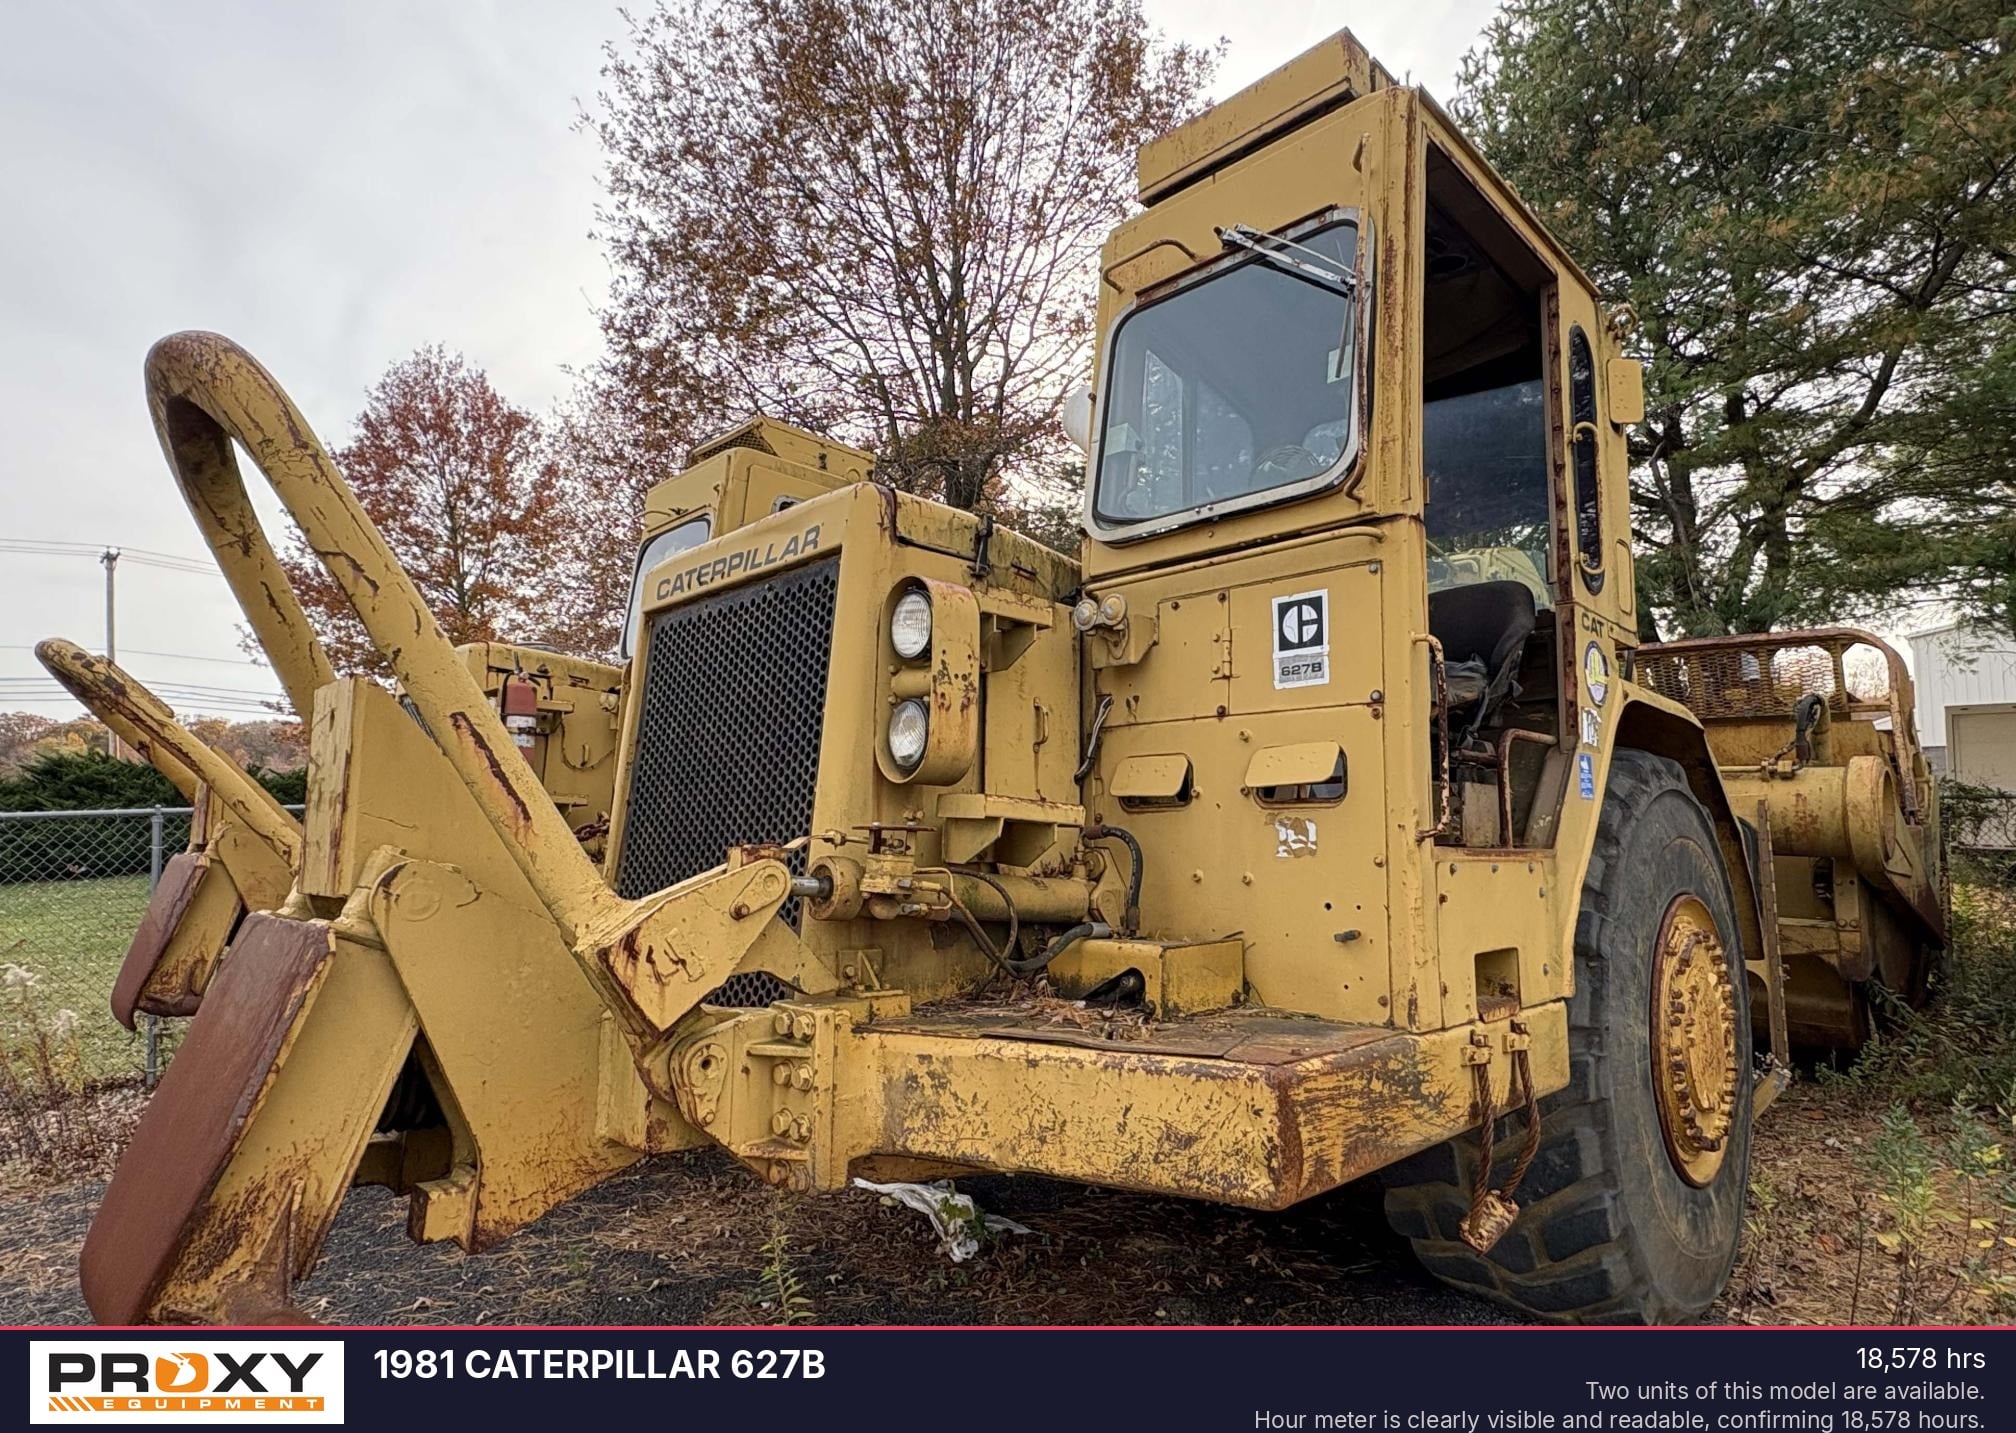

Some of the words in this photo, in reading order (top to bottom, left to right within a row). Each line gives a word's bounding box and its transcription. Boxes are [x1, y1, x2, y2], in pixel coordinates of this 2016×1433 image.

[656, 524, 822, 601] CATERPILLAR
[1581, 612, 1605, 639] CAT
[1281, 662, 1322, 677] 627B
